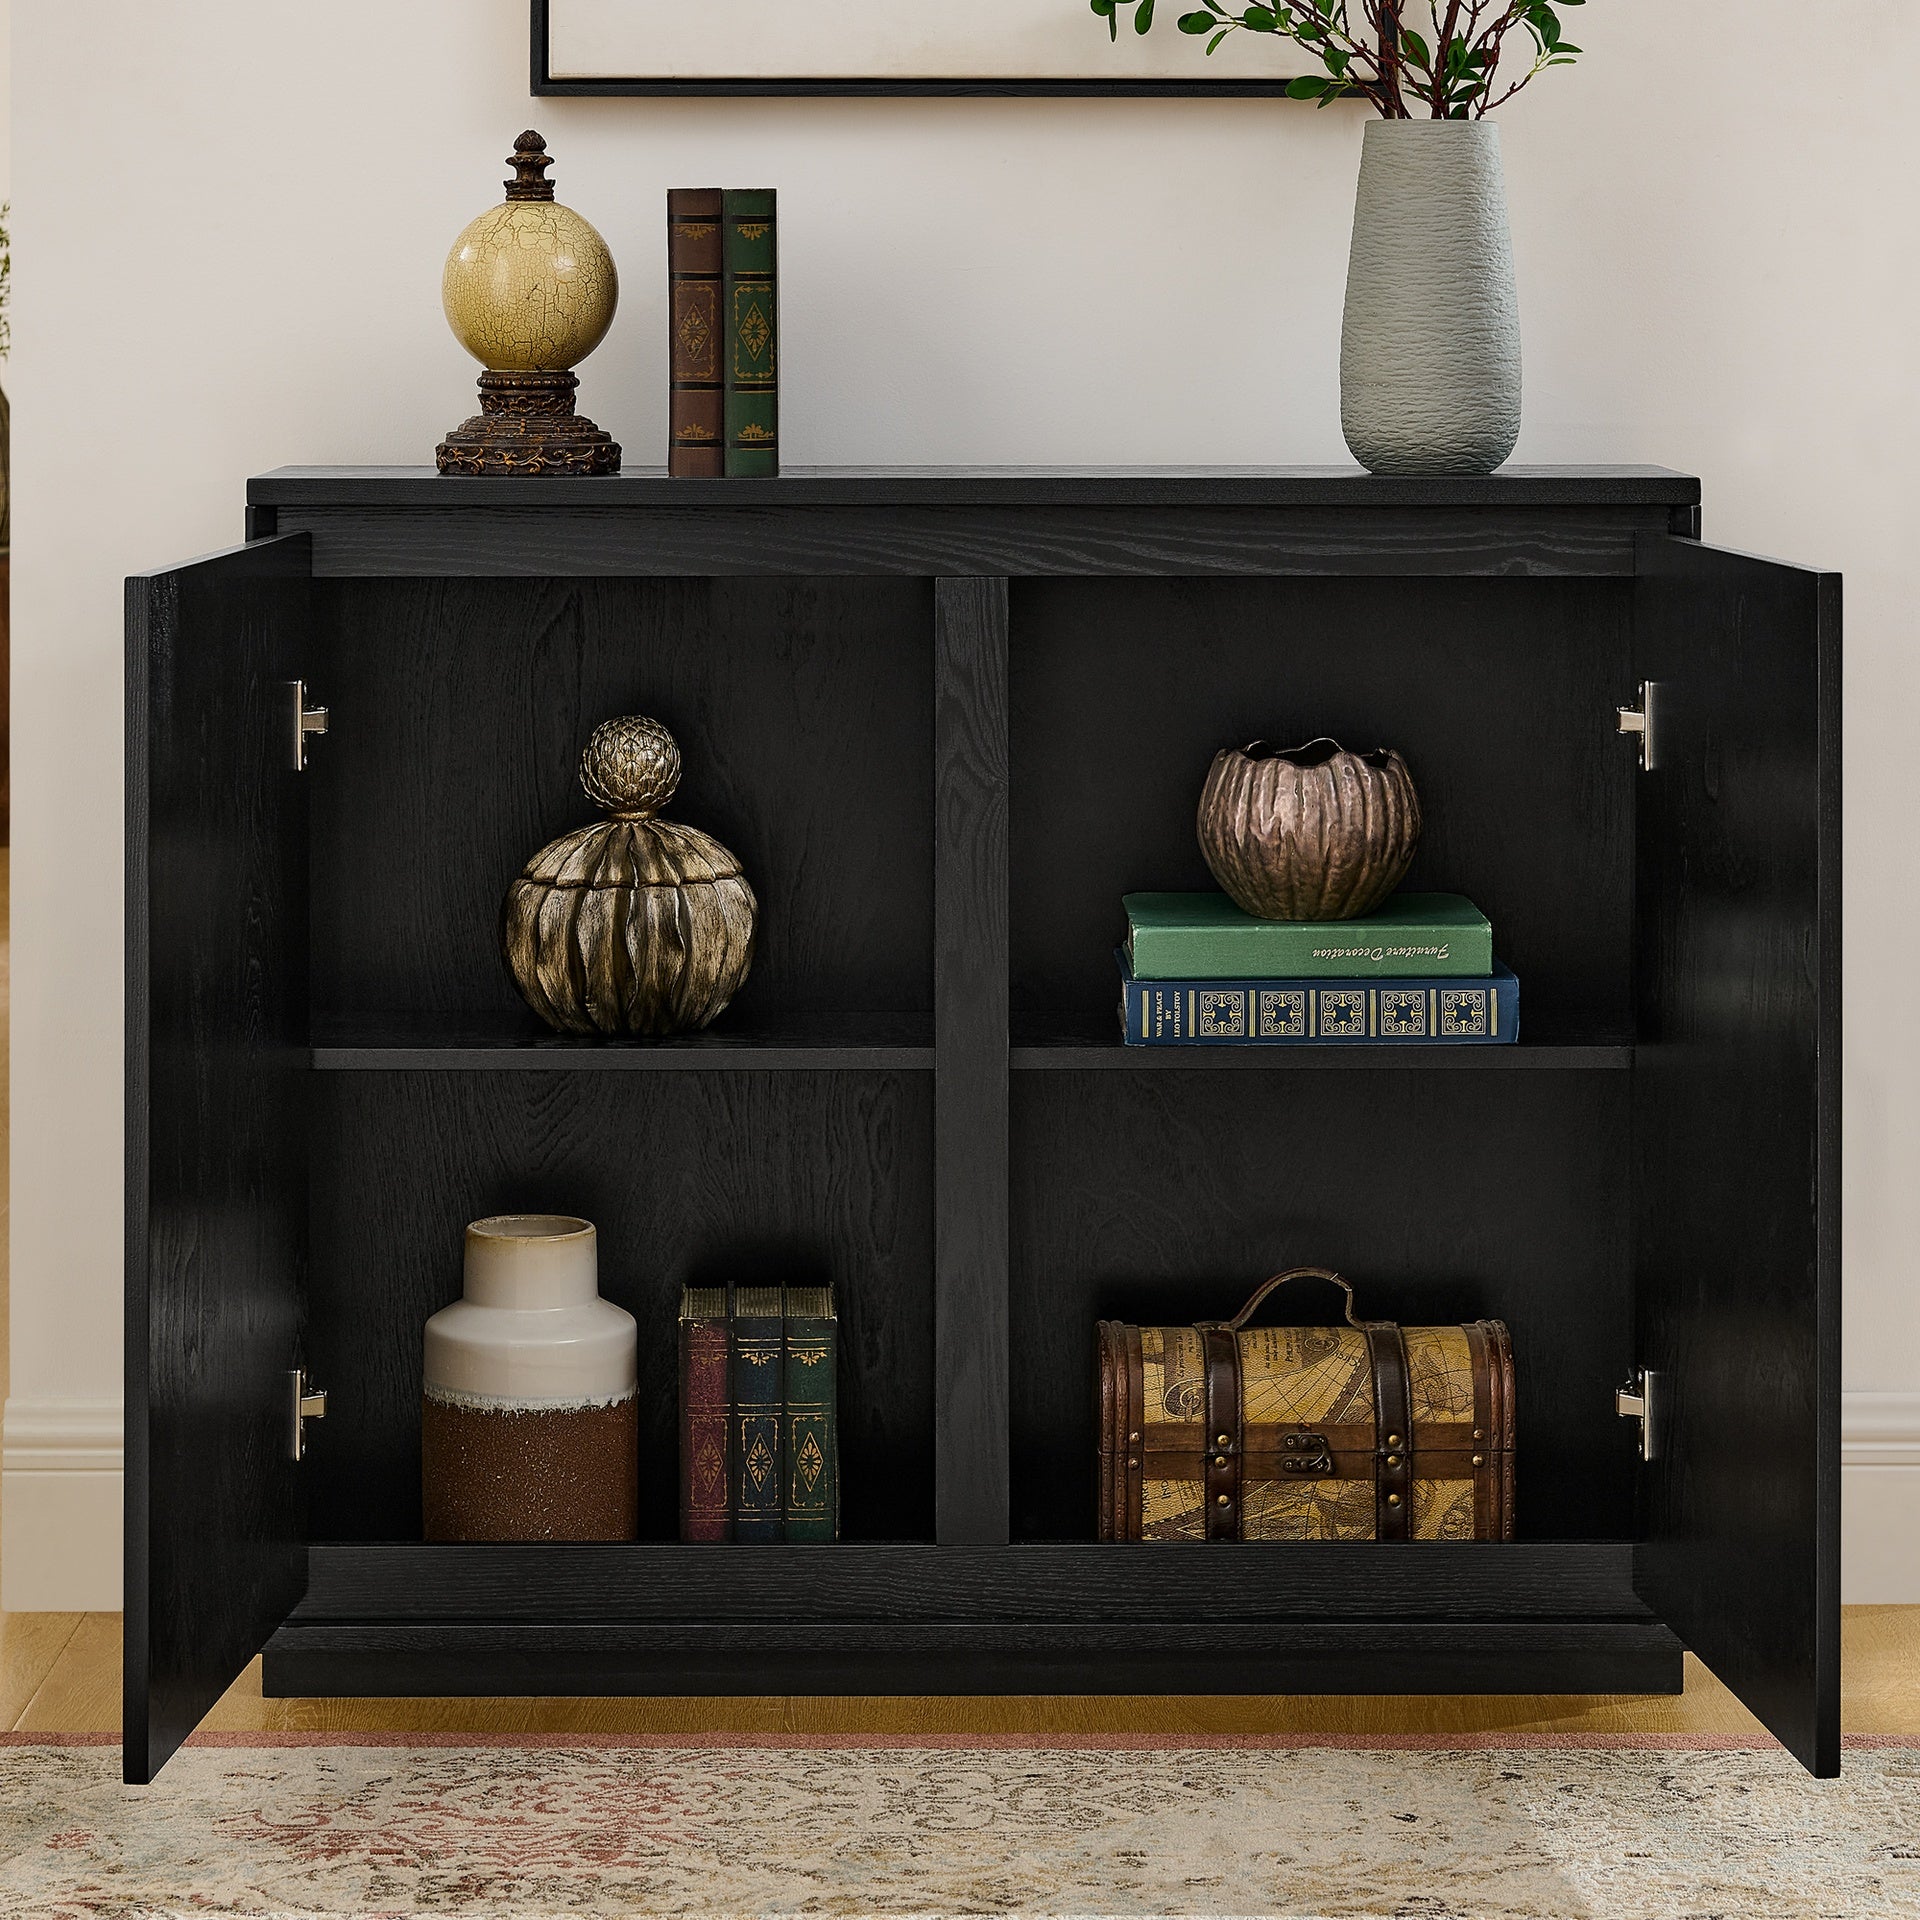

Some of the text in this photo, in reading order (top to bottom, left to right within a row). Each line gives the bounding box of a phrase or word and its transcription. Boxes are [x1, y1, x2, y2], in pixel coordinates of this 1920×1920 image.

[1312, 943, 1449, 961] Furniture Decoration
[1165, 1009, 1172, 1020] BY
